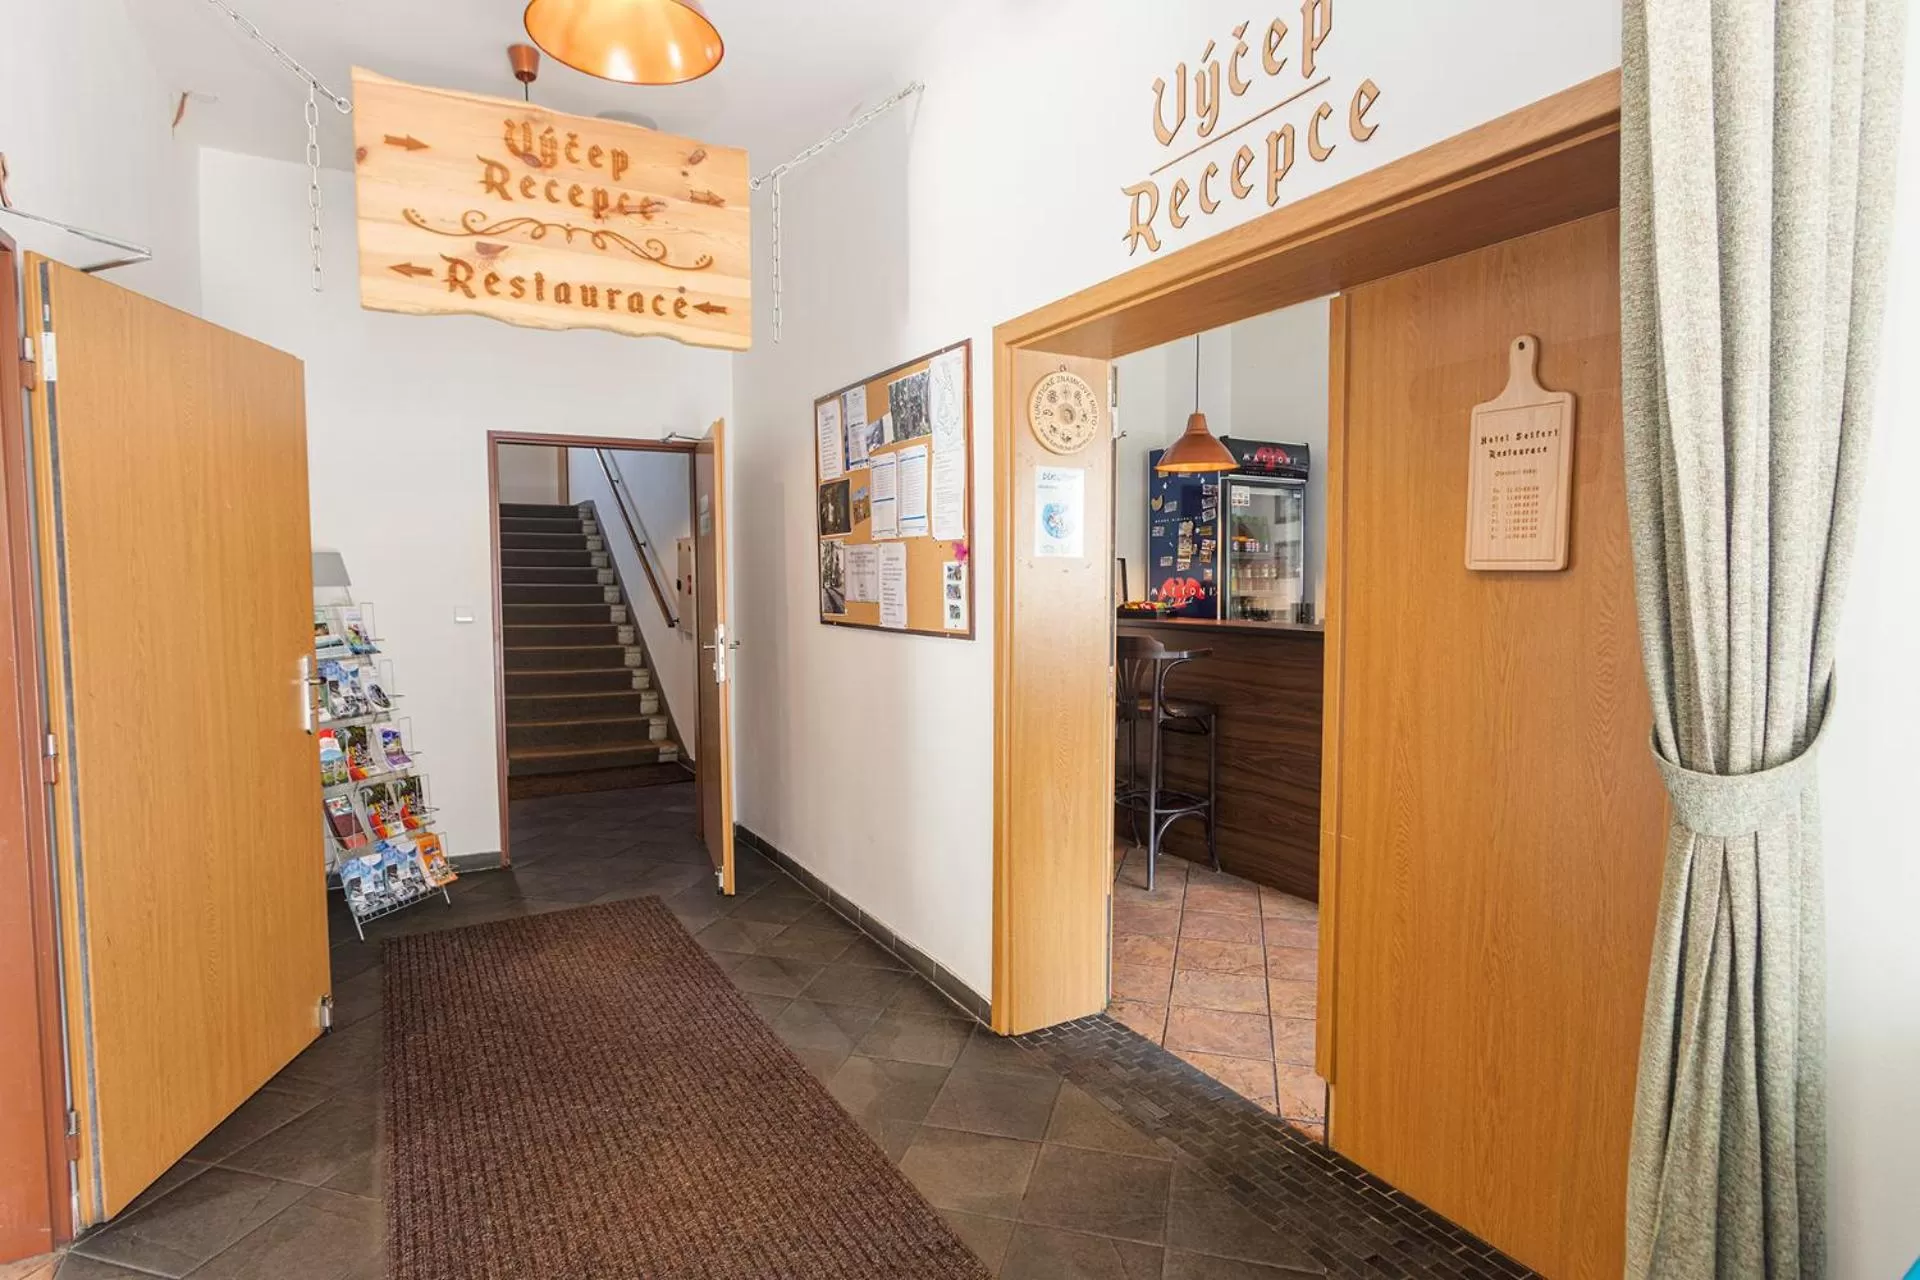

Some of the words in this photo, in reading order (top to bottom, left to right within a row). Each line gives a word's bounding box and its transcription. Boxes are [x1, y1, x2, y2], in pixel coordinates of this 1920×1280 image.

[1152, 0, 1333, 147] Výčep
[503, 117, 631, 182] Výčep
[1121, 78, 1381, 257] Recepce
[476, 153, 658, 221] Recepce
[439, 253, 690, 319] Restaurace
[1481, 434, 1509, 445] Hotel
[1516, 429, 1558, 441] Seifert
